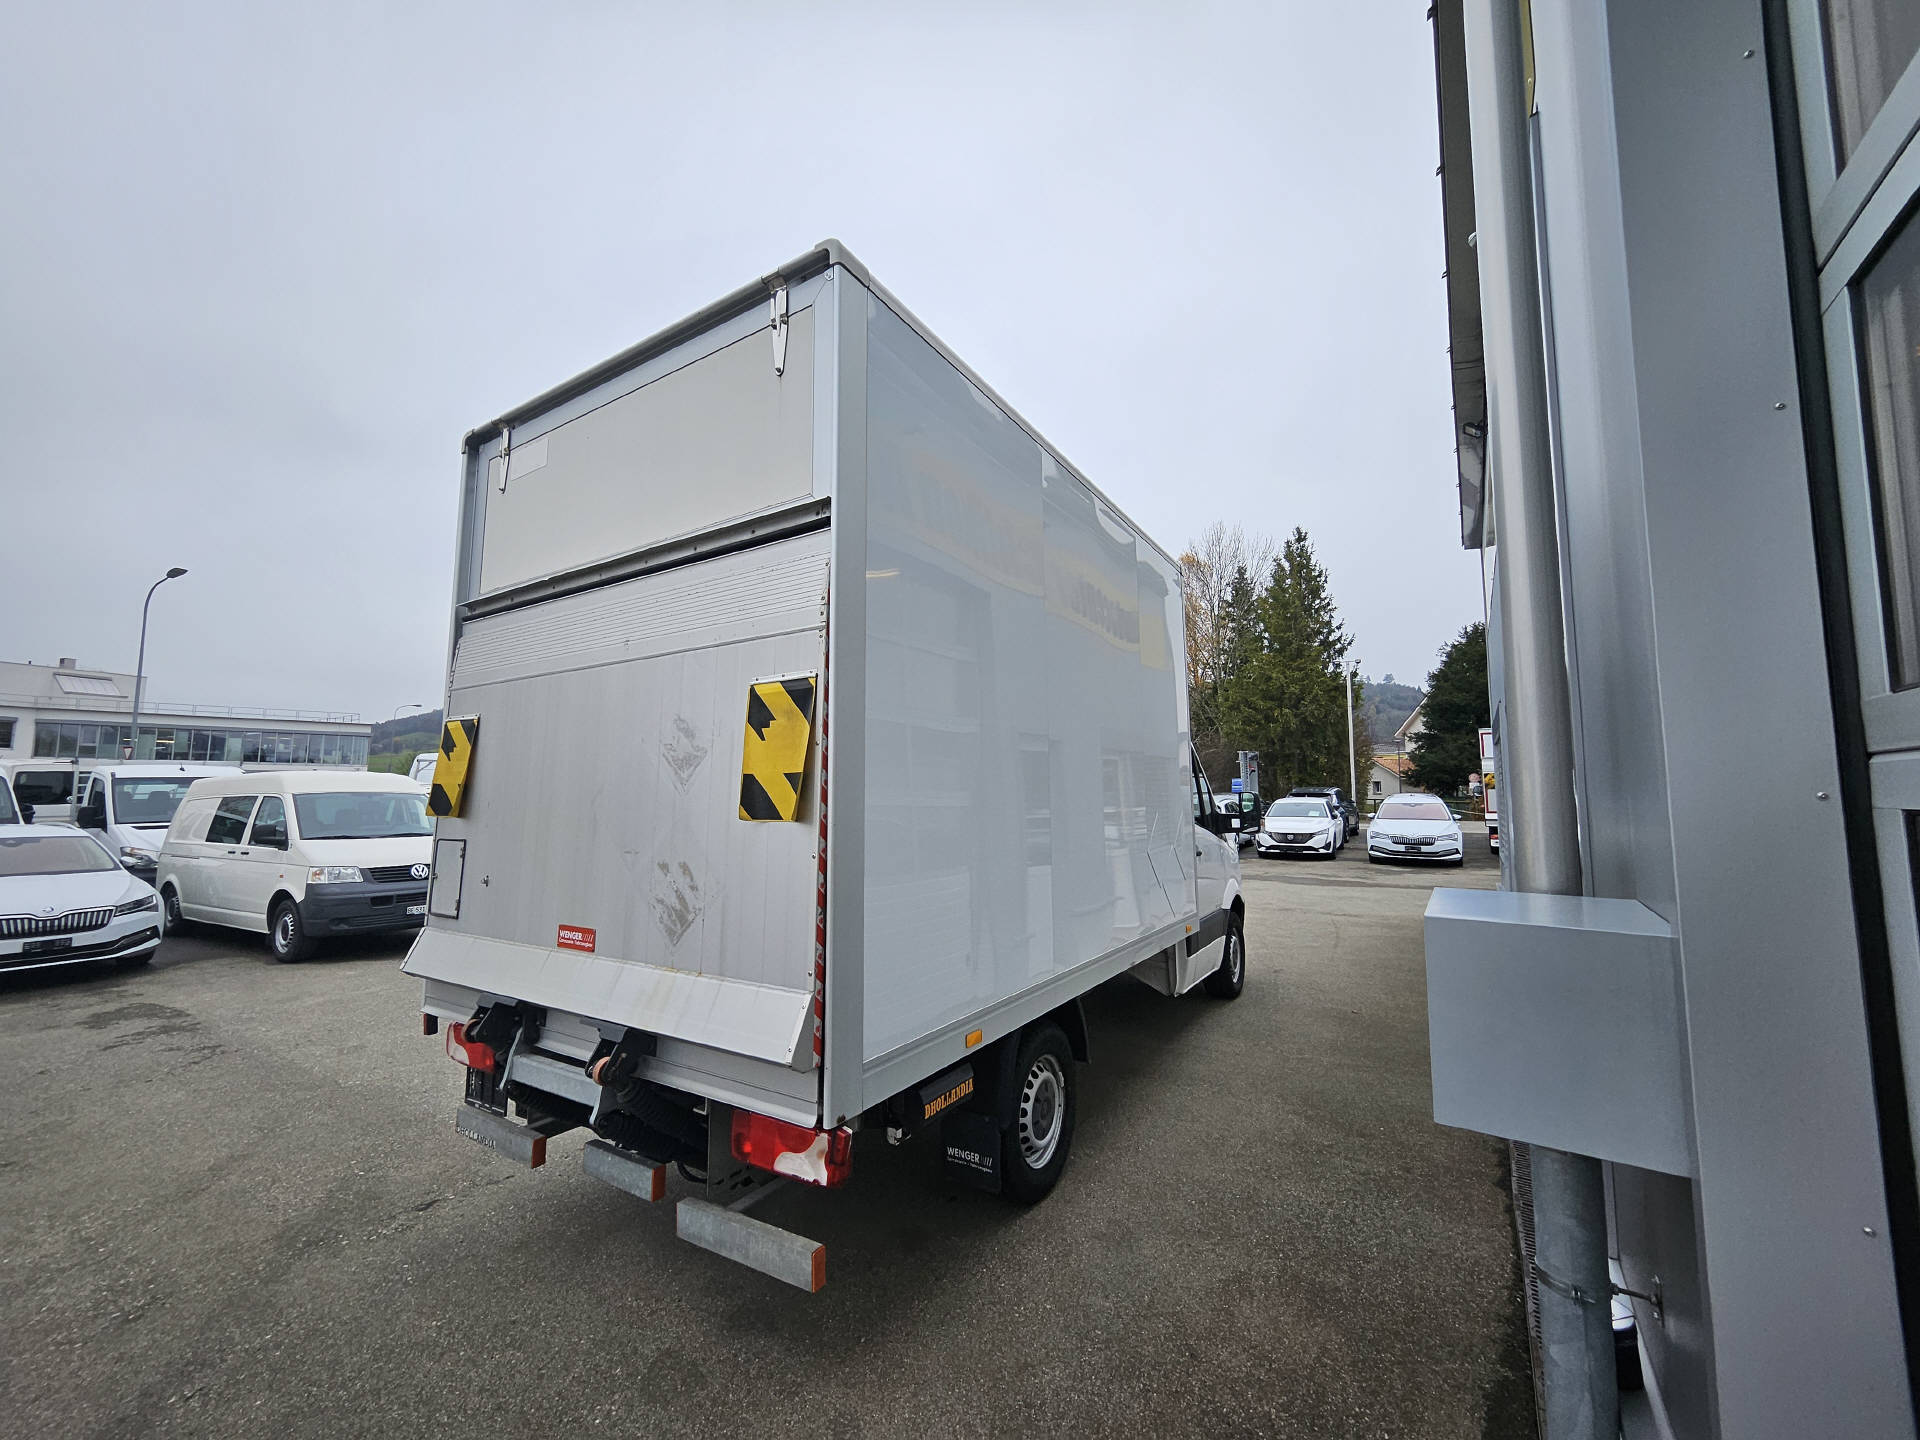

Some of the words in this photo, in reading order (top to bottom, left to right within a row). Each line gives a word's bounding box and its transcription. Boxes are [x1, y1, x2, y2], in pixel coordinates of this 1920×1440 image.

[559, 929, 582, 941] WENGER
[924, 1078, 974, 1120] DHOLLANDIA
[947, 1146, 980, 1164] WENGER
